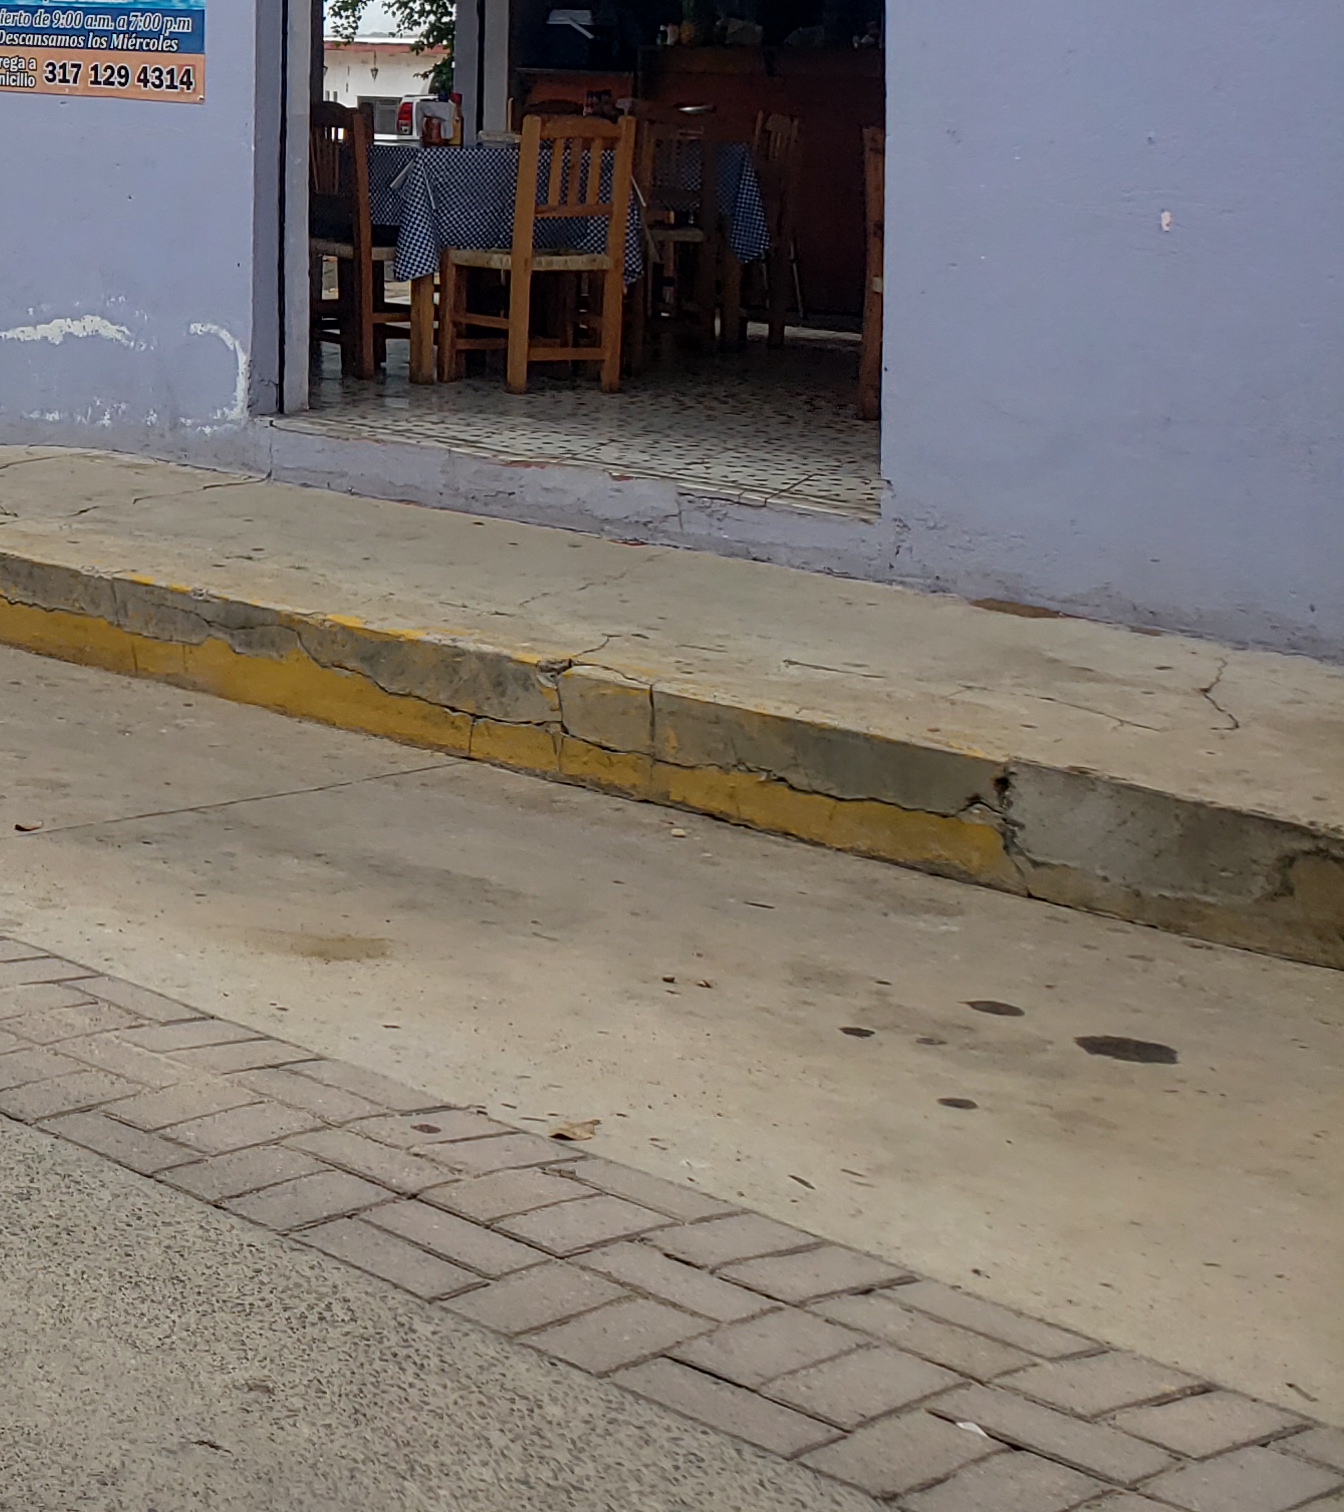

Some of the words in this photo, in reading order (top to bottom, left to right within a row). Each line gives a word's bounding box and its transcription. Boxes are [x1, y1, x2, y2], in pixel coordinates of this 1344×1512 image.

[34, 9, 49, 28] de
[52, 10, 82, 29] 9:00
[117, 15, 128, 30] a
[129, 12, 162, 31] 7:00
[87, 31, 108, 49] los
[110, 33, 179, 53] Miércoles
[28, 58, 38, 70] a
[43, 59, 82, 85] 317
[88, 62, 131, 87] 129
[135, 64, 195, 92] 4314
